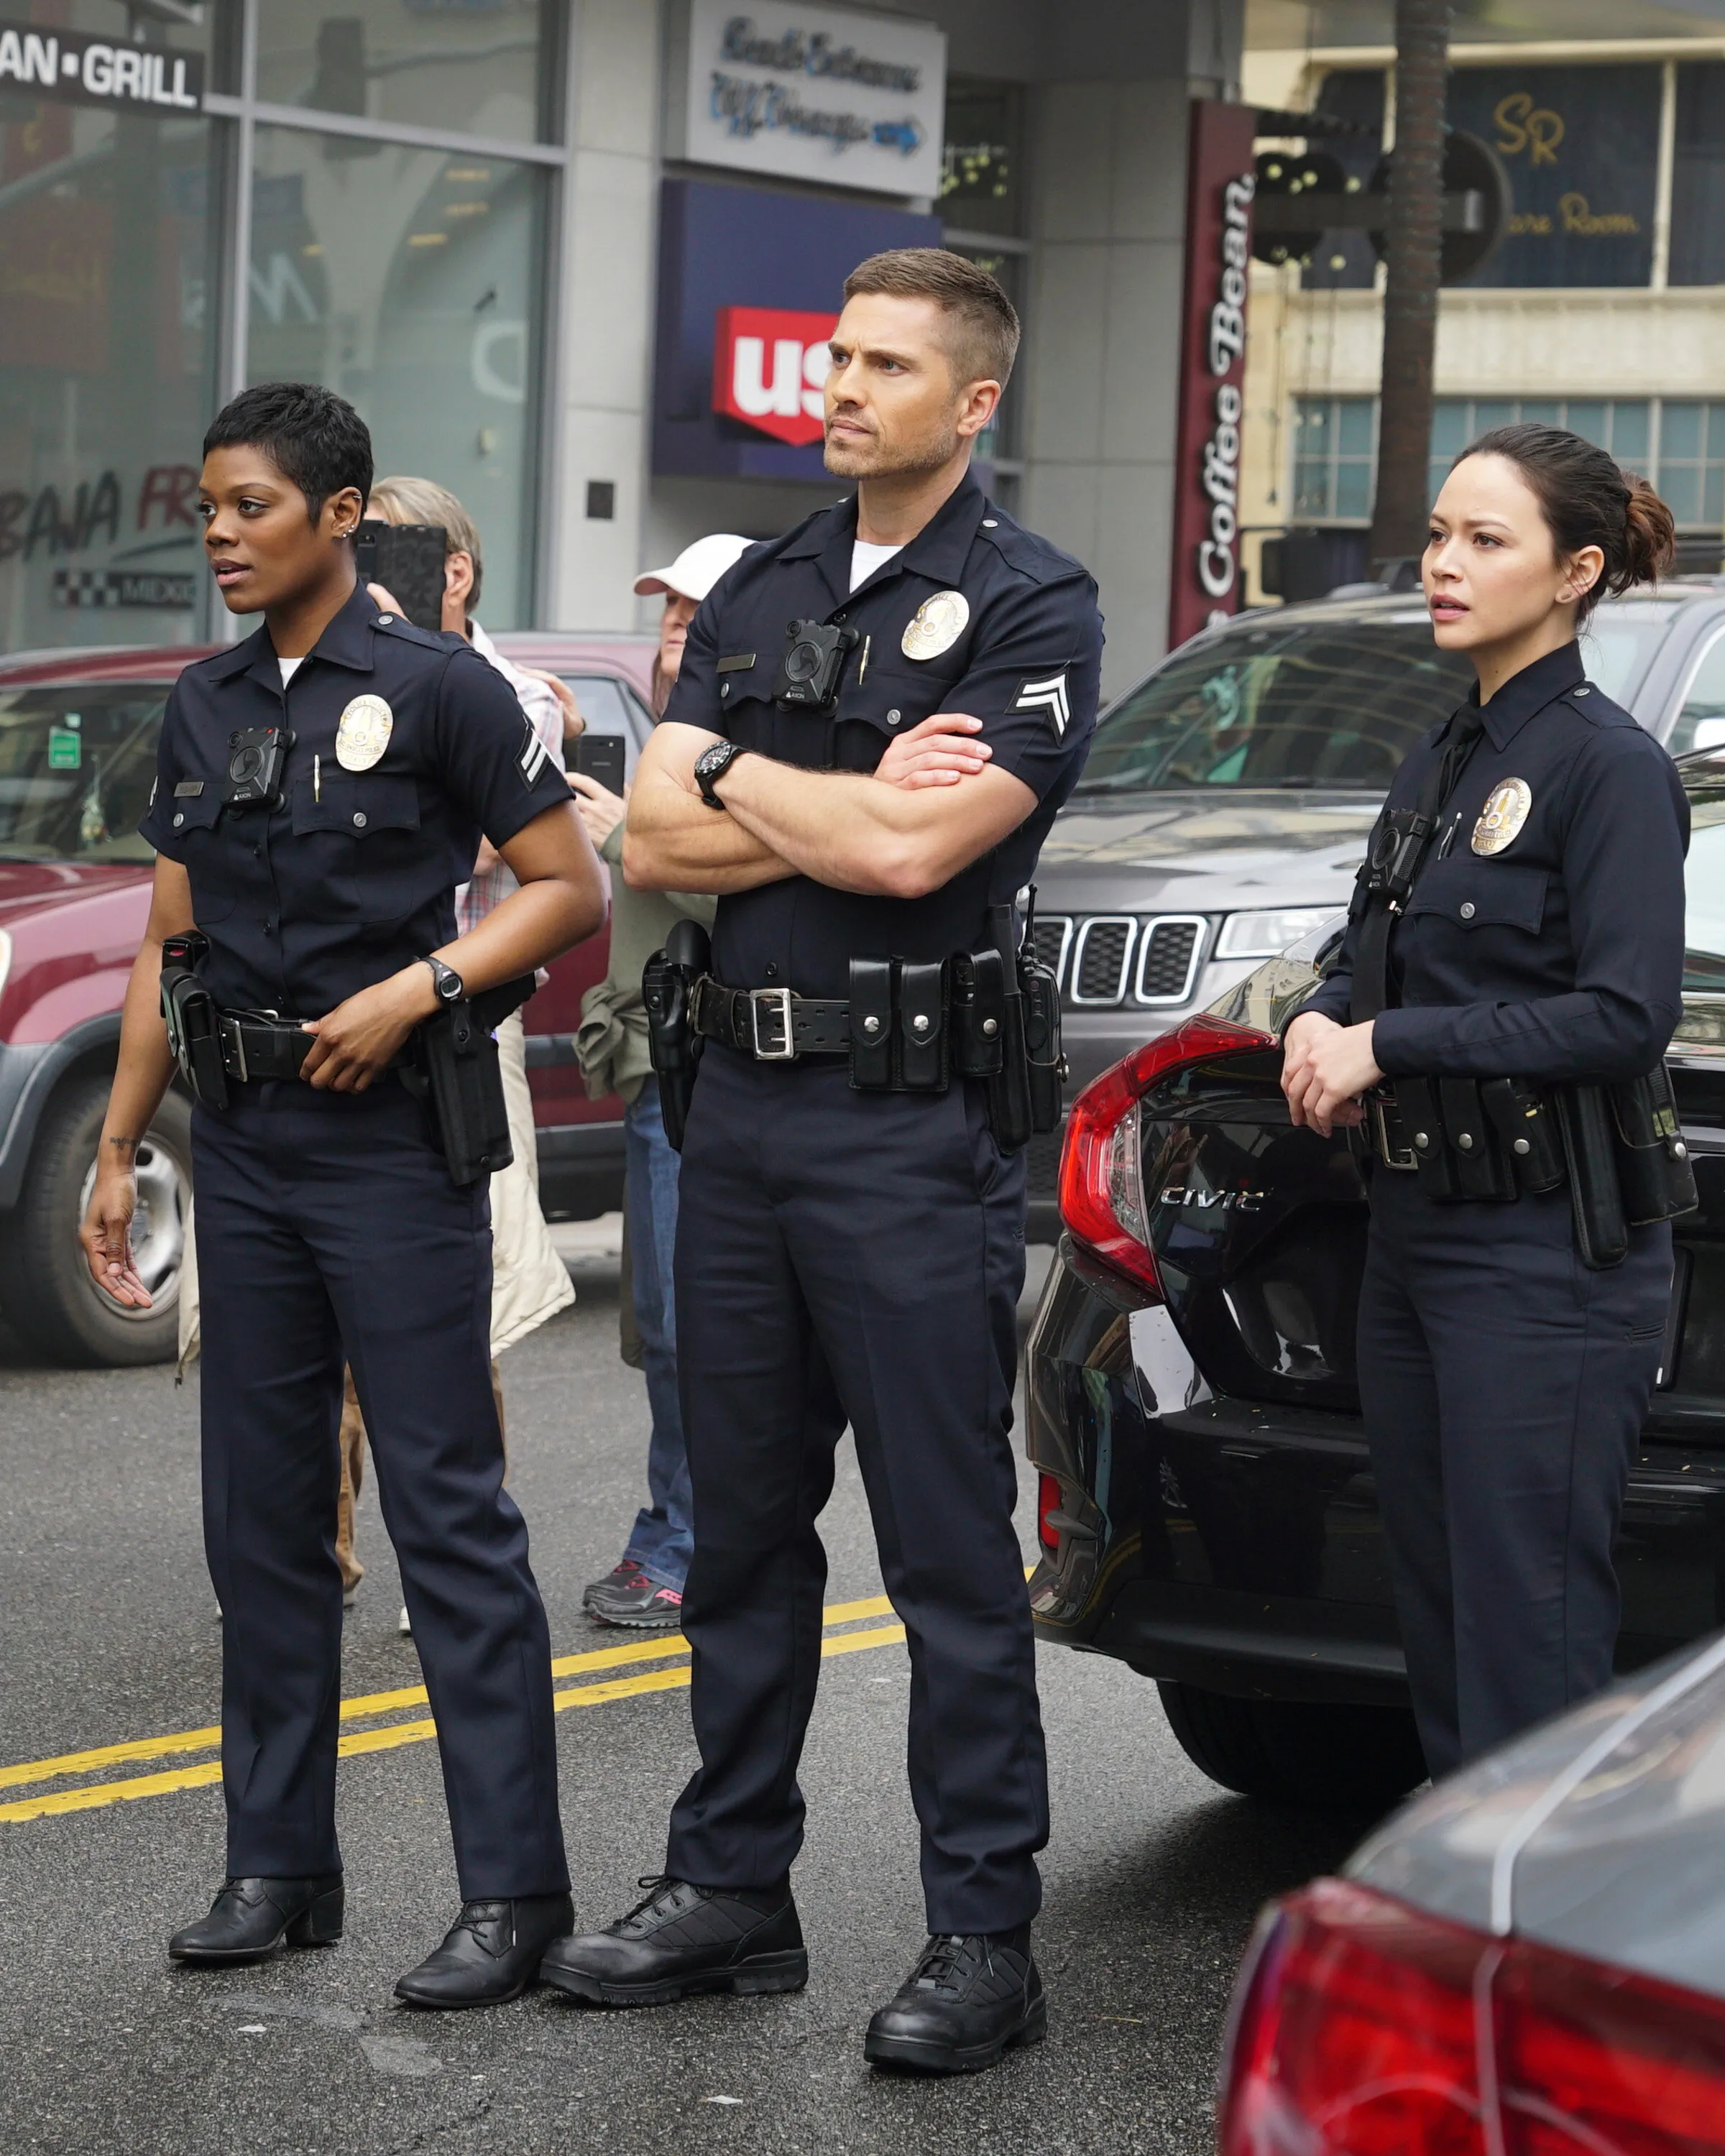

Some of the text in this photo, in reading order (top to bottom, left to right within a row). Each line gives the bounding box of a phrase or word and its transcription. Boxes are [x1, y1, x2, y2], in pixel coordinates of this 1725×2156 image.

[0, 29, 198, 108] AN GRILL
[1494, 92, 1565, 166] SR
[1560, 192, 1640, 235] Room
[1210, 172, 1256, 377] Bean
[1199, 383, 1241, 597] Coffee
[1160, 1187, 1264, 1212] CIVIC
